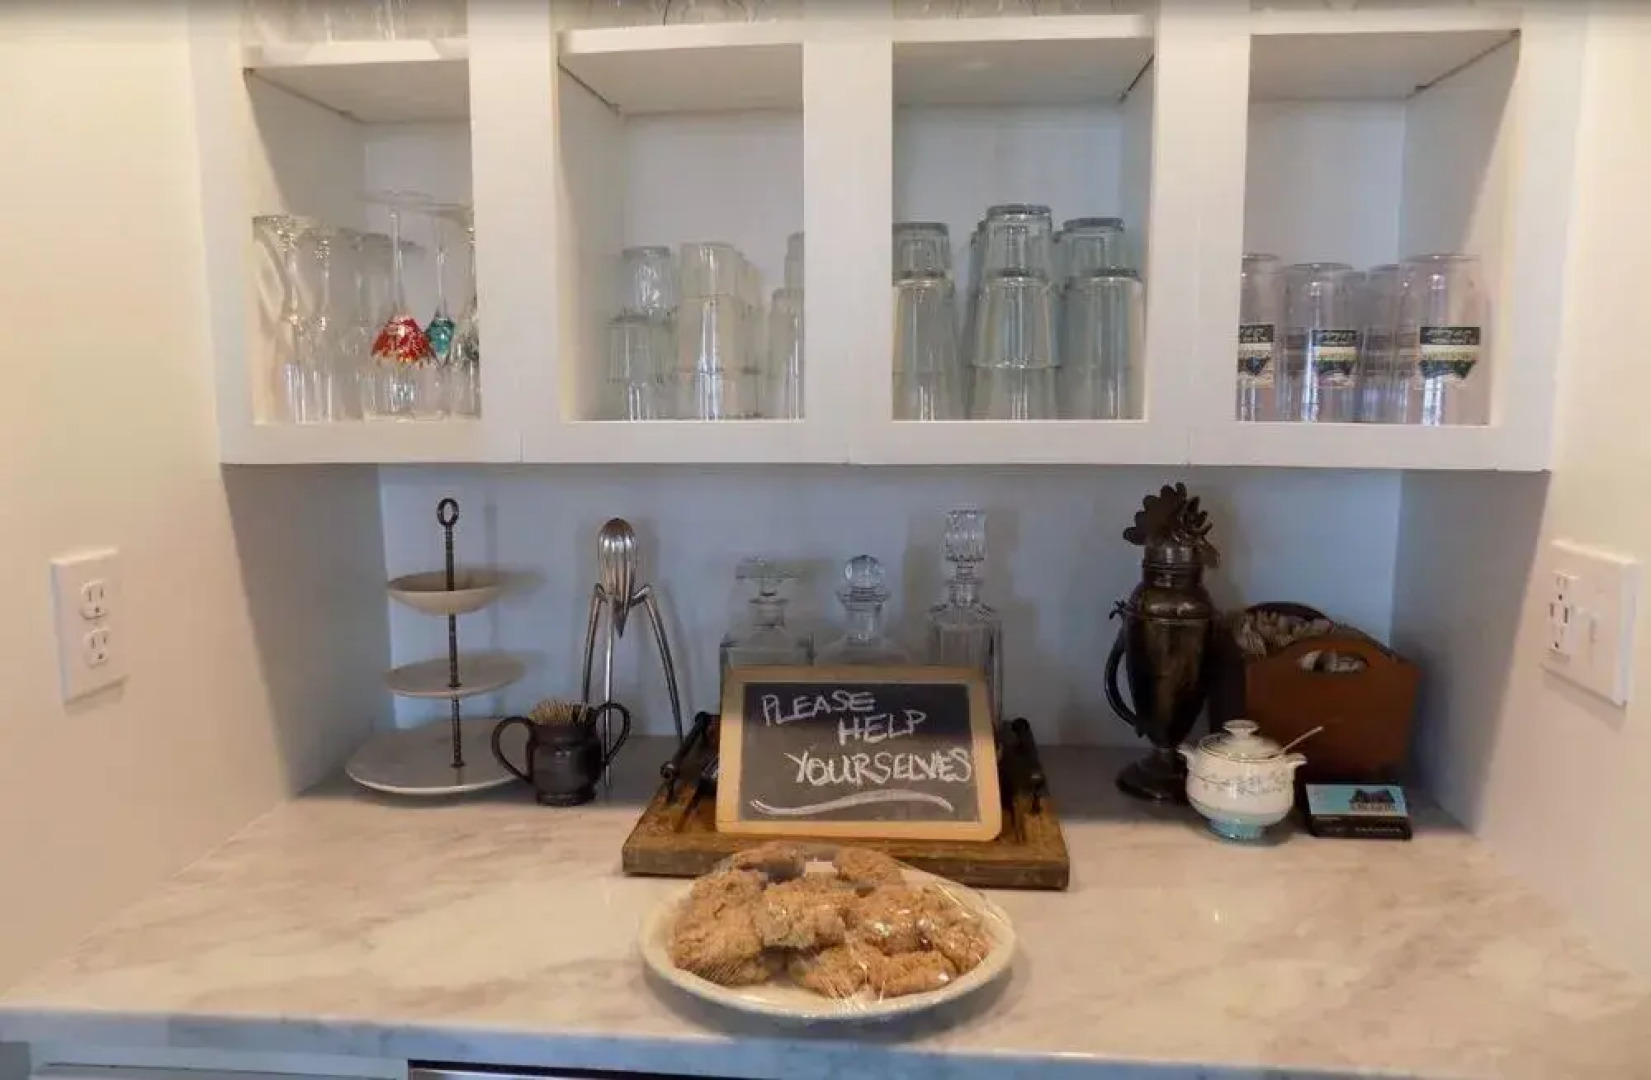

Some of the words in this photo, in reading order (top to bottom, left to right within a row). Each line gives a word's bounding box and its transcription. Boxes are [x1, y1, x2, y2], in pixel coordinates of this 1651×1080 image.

[761, 689, 876, 727] PLEASE
[836, 709, 927, 746] HELP
[783, 746, 972, 787] YOURSELVES
